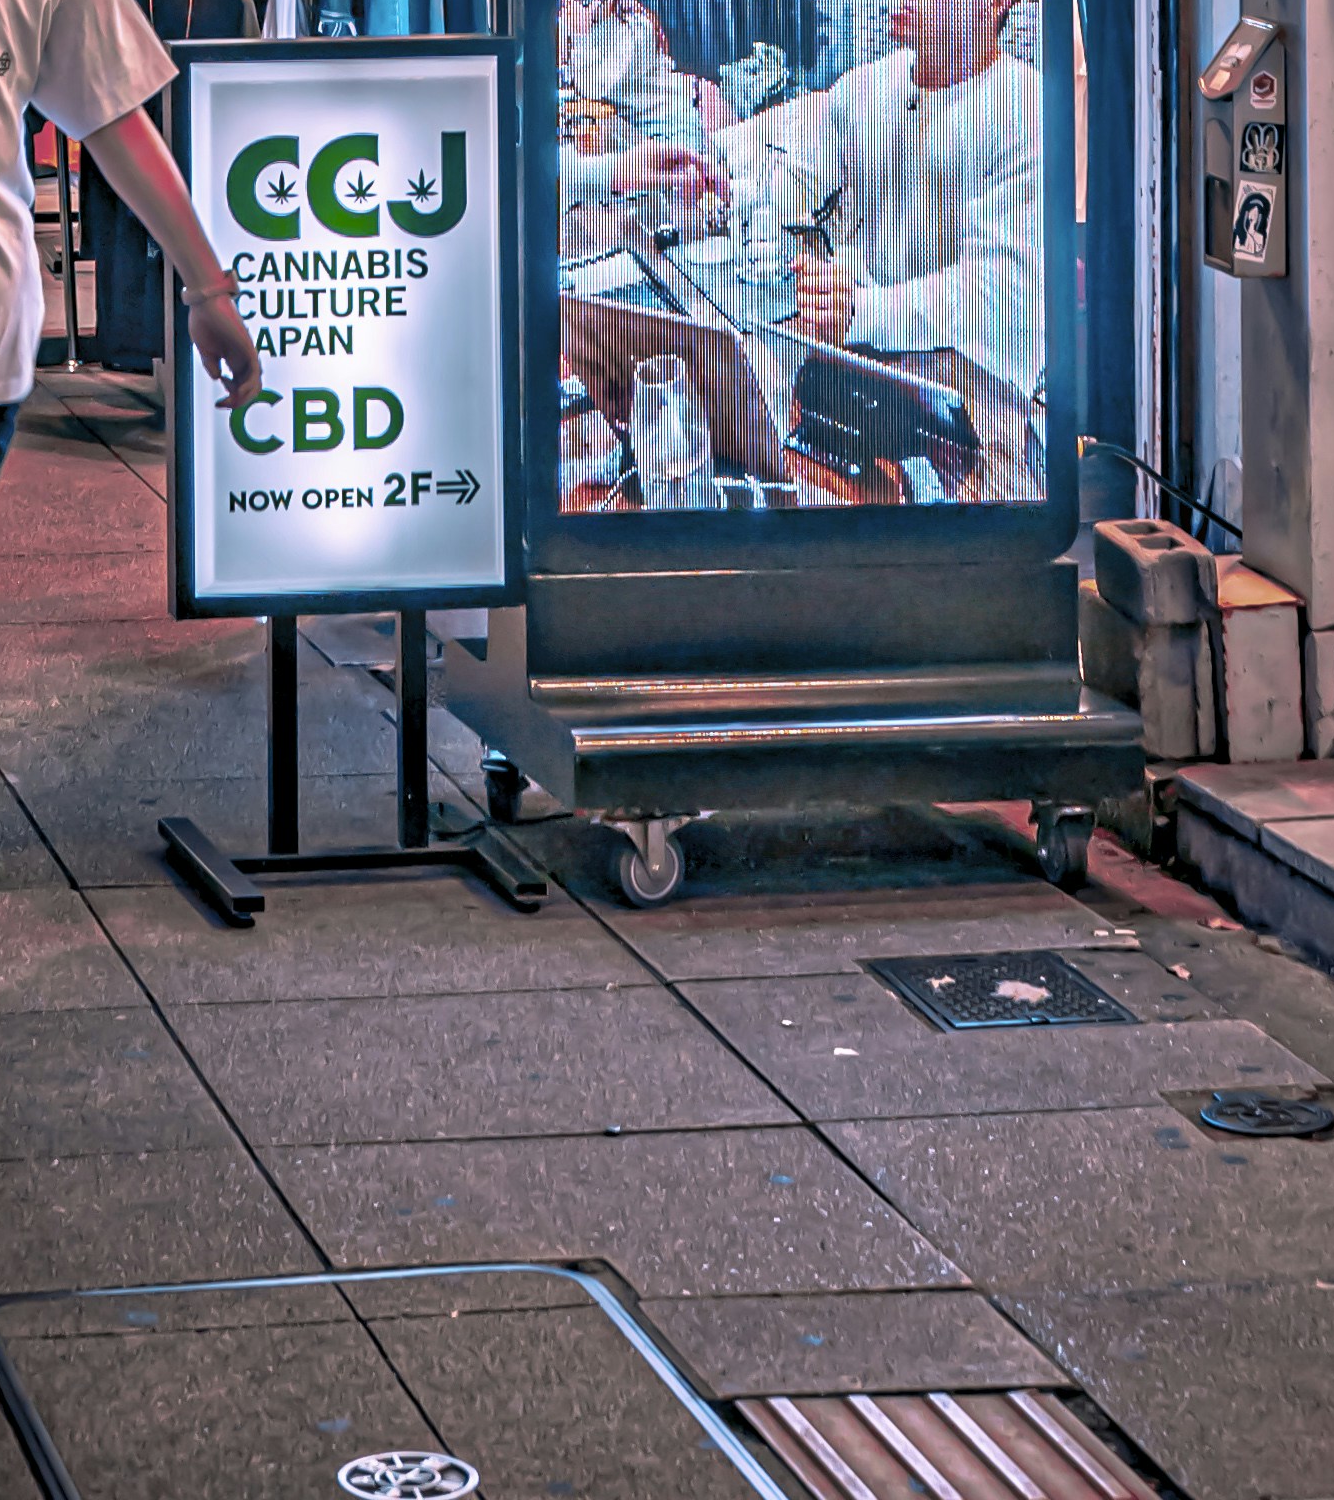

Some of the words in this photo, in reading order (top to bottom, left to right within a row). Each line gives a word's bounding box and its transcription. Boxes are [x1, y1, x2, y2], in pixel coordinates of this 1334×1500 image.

[226, 129, 468, 243] CCJ
[233, 247, 429, 285] CANNABIS
[235, 286, 408, 321] CULTURE
[251, 325, 355, 359] APAN
[229, 386, 405, 456] CBD
[229, 488, 294, 513] NOW
[301, 486, 374, 511] OPEN
[383, 471, 434, 508] 2F
